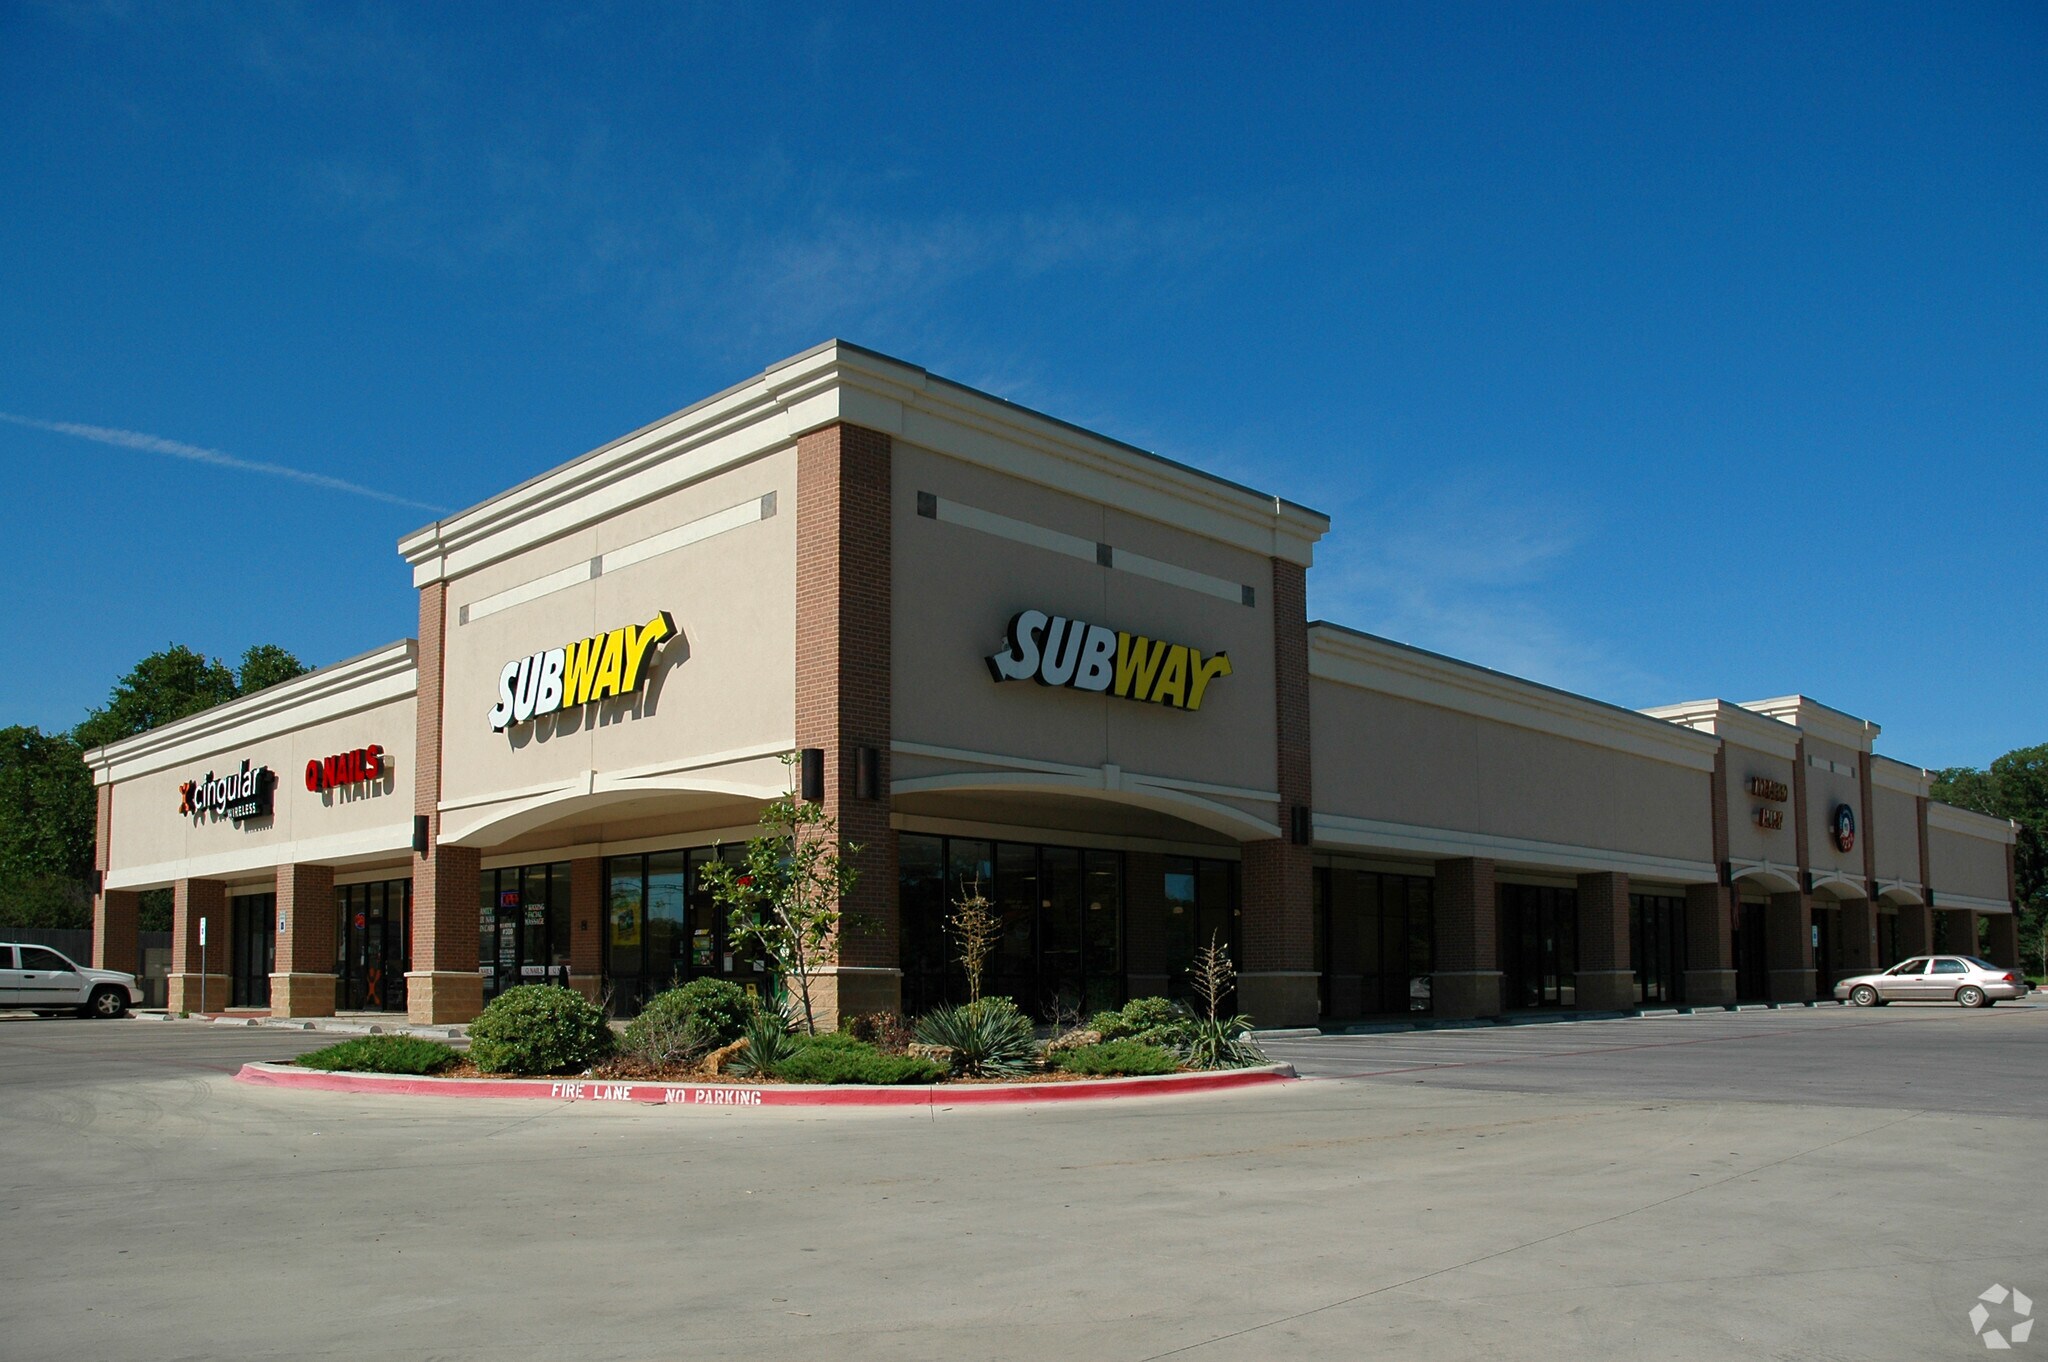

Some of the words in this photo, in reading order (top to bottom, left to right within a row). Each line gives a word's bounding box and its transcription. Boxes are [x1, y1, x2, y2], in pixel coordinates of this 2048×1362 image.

[487, 611, 670, 729] SUBWAY
[986, 609, 1233, 711] SUBWAY
[194, 760, 260, 815] cingular
[305, 759, 320, 793] Q
[322, 744, 382, 789] NAILS
[226, 802, 257, 818] WIRELESS
[552, 1083, 584, 1099] FIRE
[593, 1085, 633, 1101] LANE
[665, 1088, 686, 1103] NO
[695, 1089, 762, 1106] PARKING
